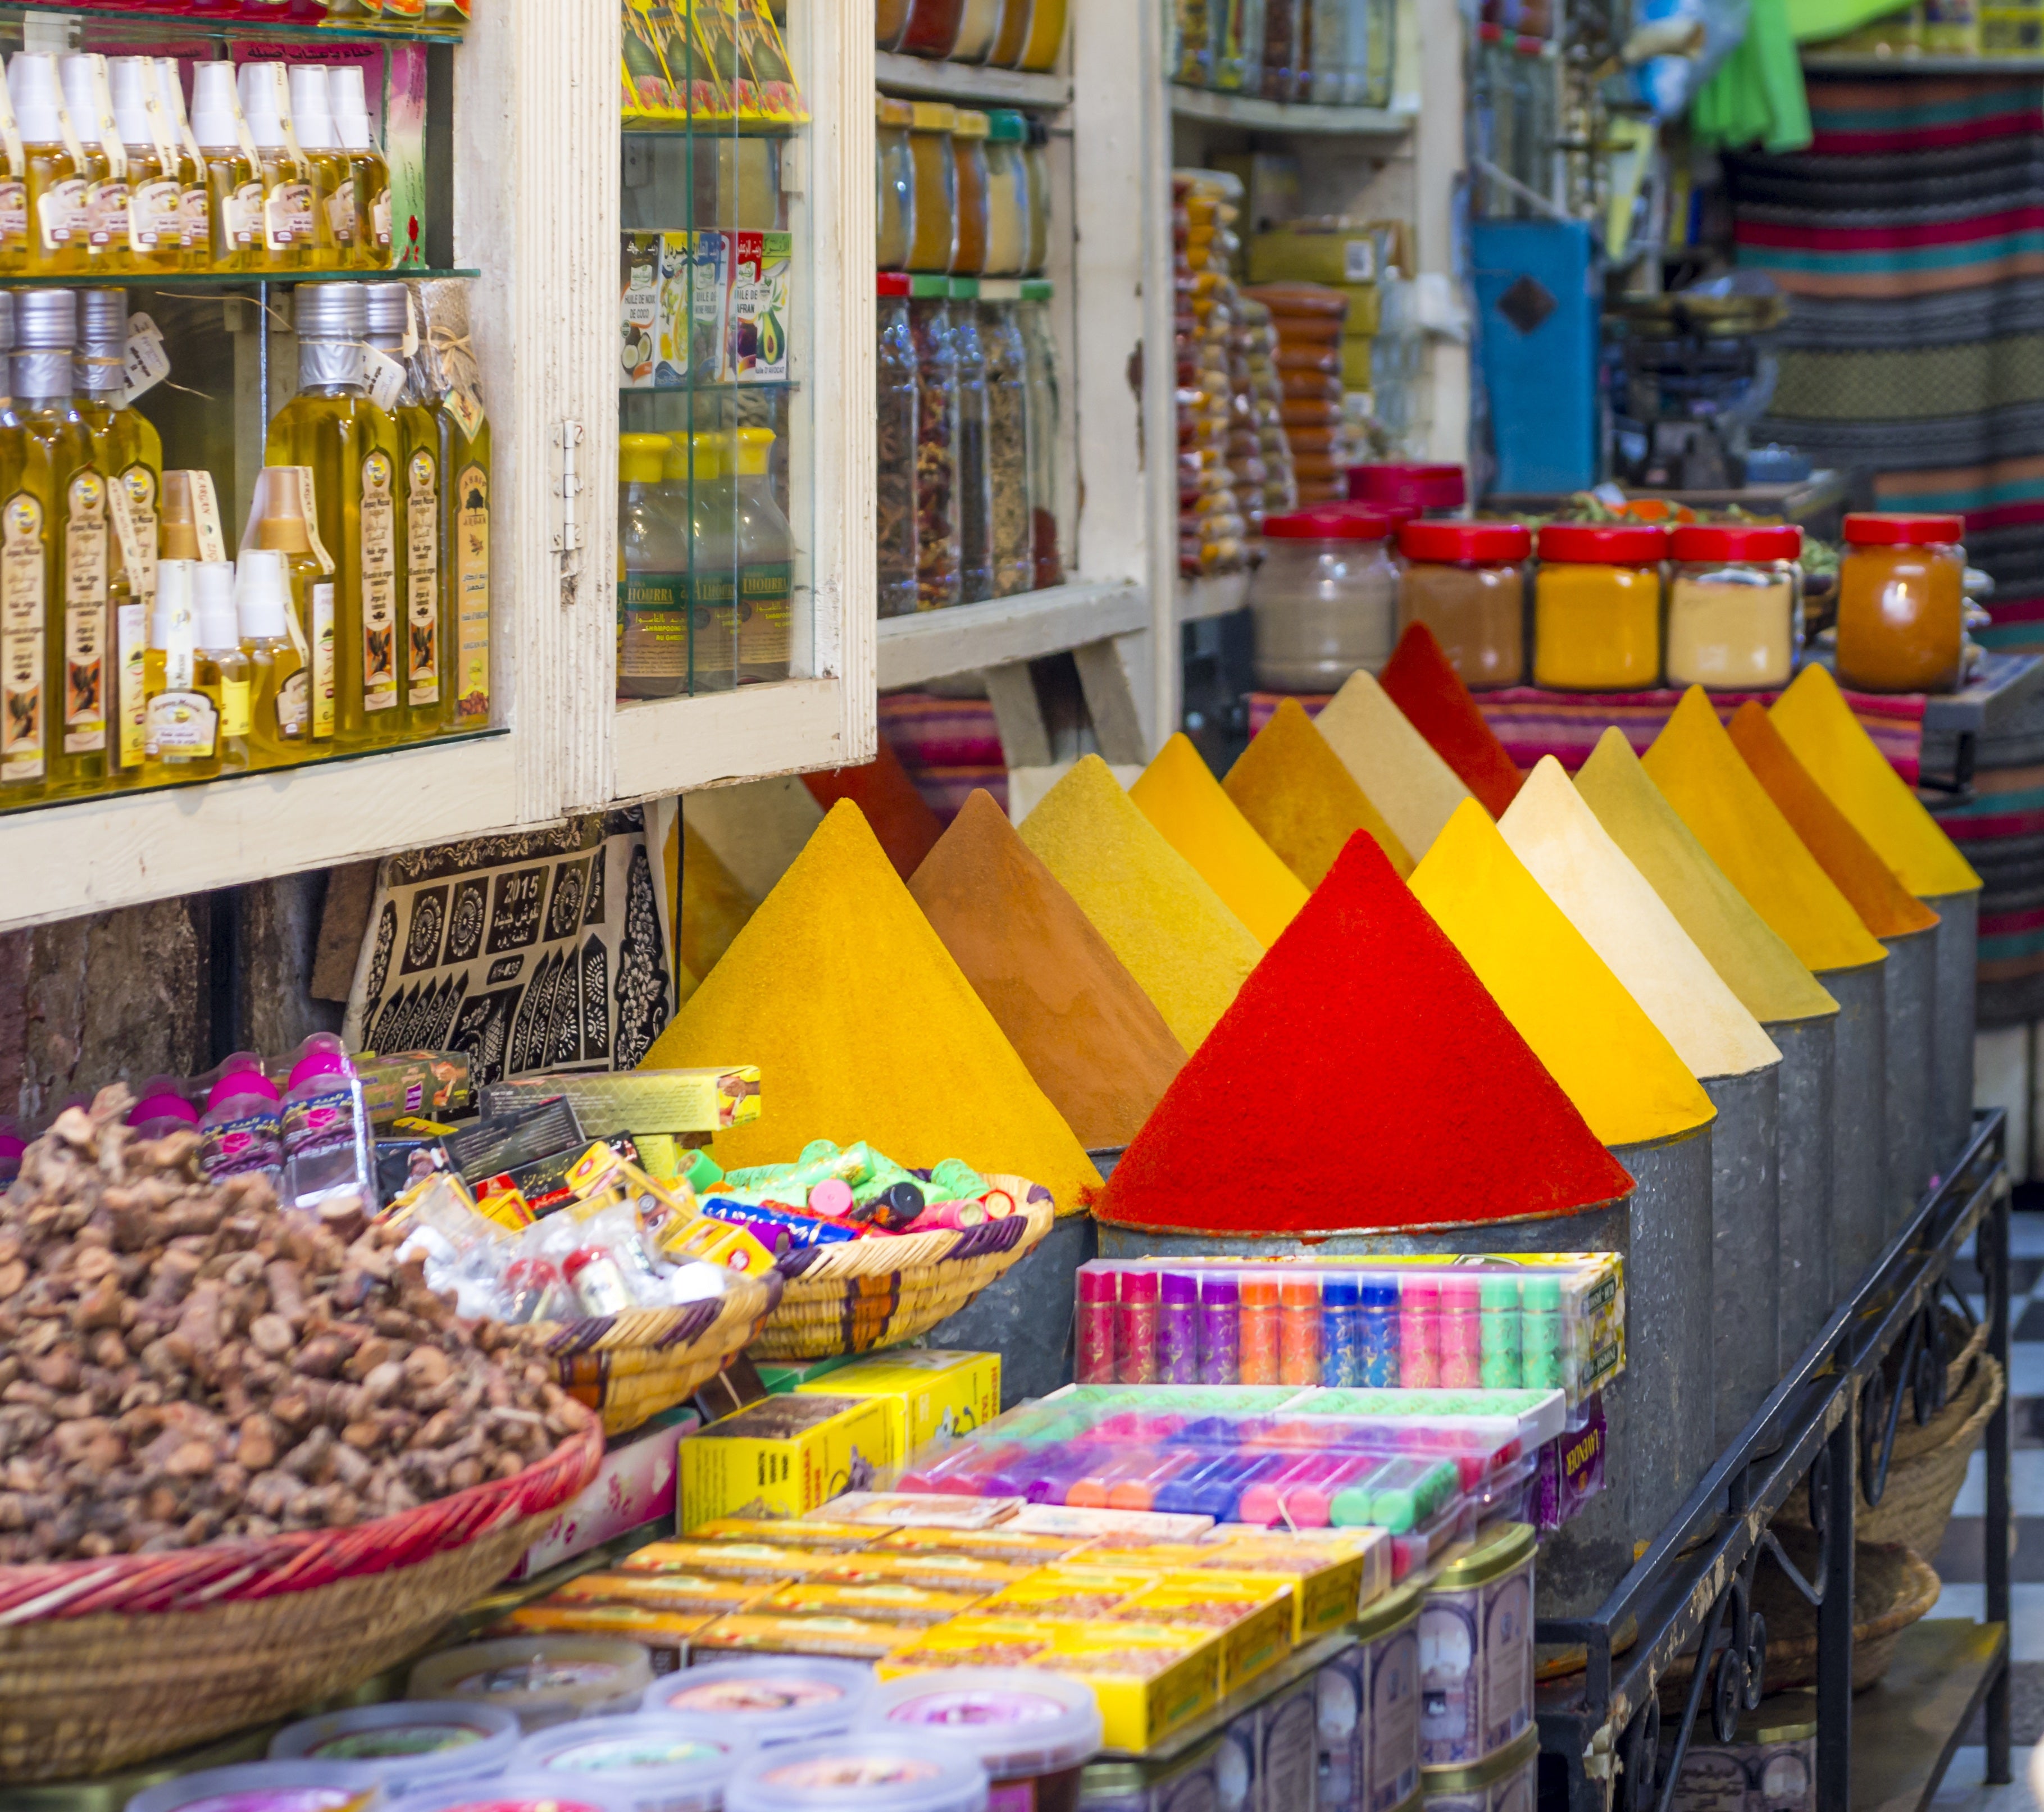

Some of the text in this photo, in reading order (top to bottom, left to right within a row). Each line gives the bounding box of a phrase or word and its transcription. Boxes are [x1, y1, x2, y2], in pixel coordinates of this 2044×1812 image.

[750, 289, 758, 299] DE
[737, 303, 755, 313] AFRAN
[630, 309, 636, 318] DE
[628, 588, 673, 602] HOURRA
[504, 875, 539, 904] 2015
